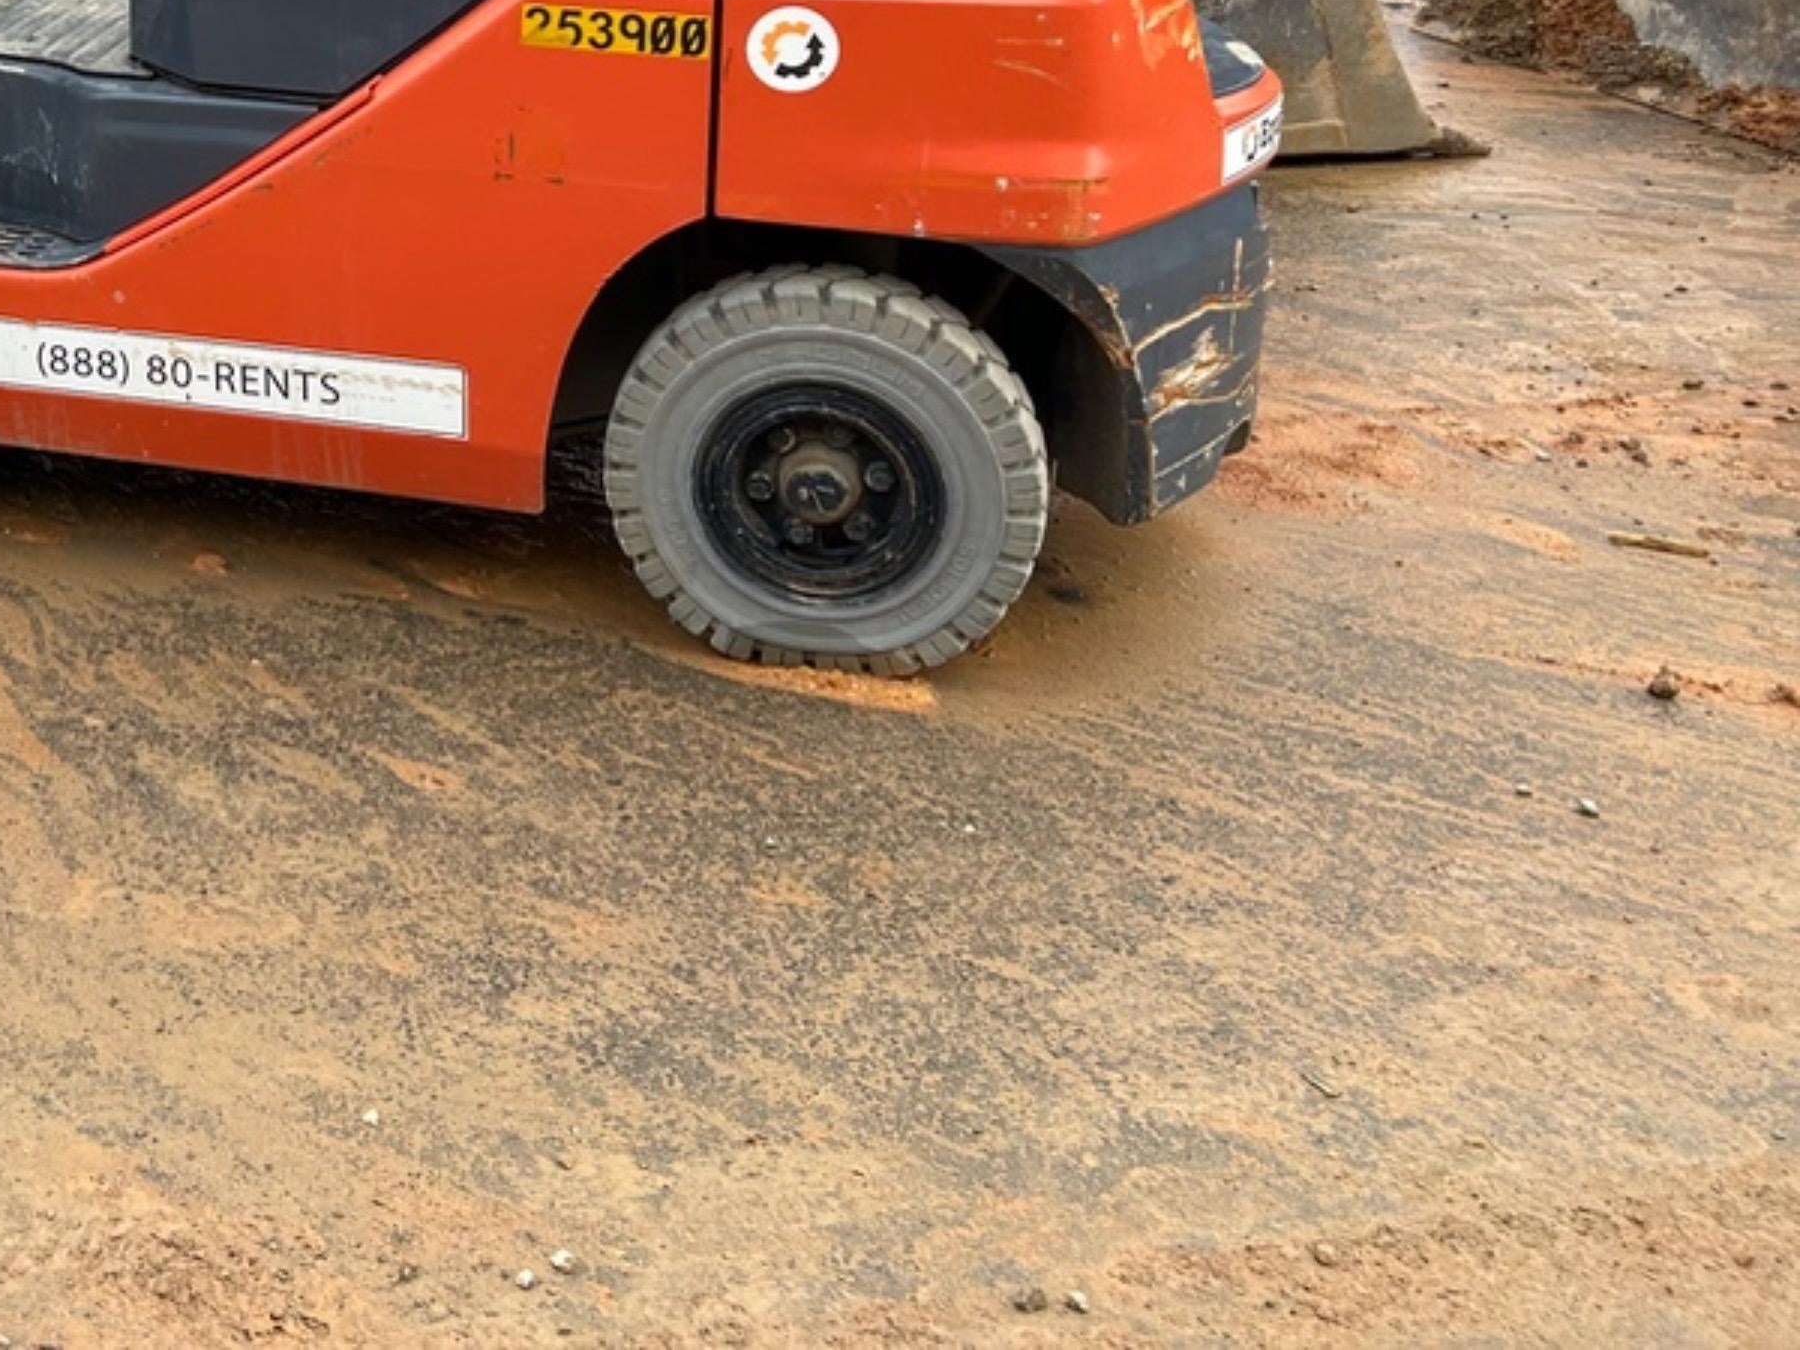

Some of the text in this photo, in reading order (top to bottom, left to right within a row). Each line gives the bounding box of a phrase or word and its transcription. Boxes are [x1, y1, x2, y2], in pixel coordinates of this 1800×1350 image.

[525, 6, 707, 56] 253900
[37, 341, 341, 405] (888) 80-RENTS
